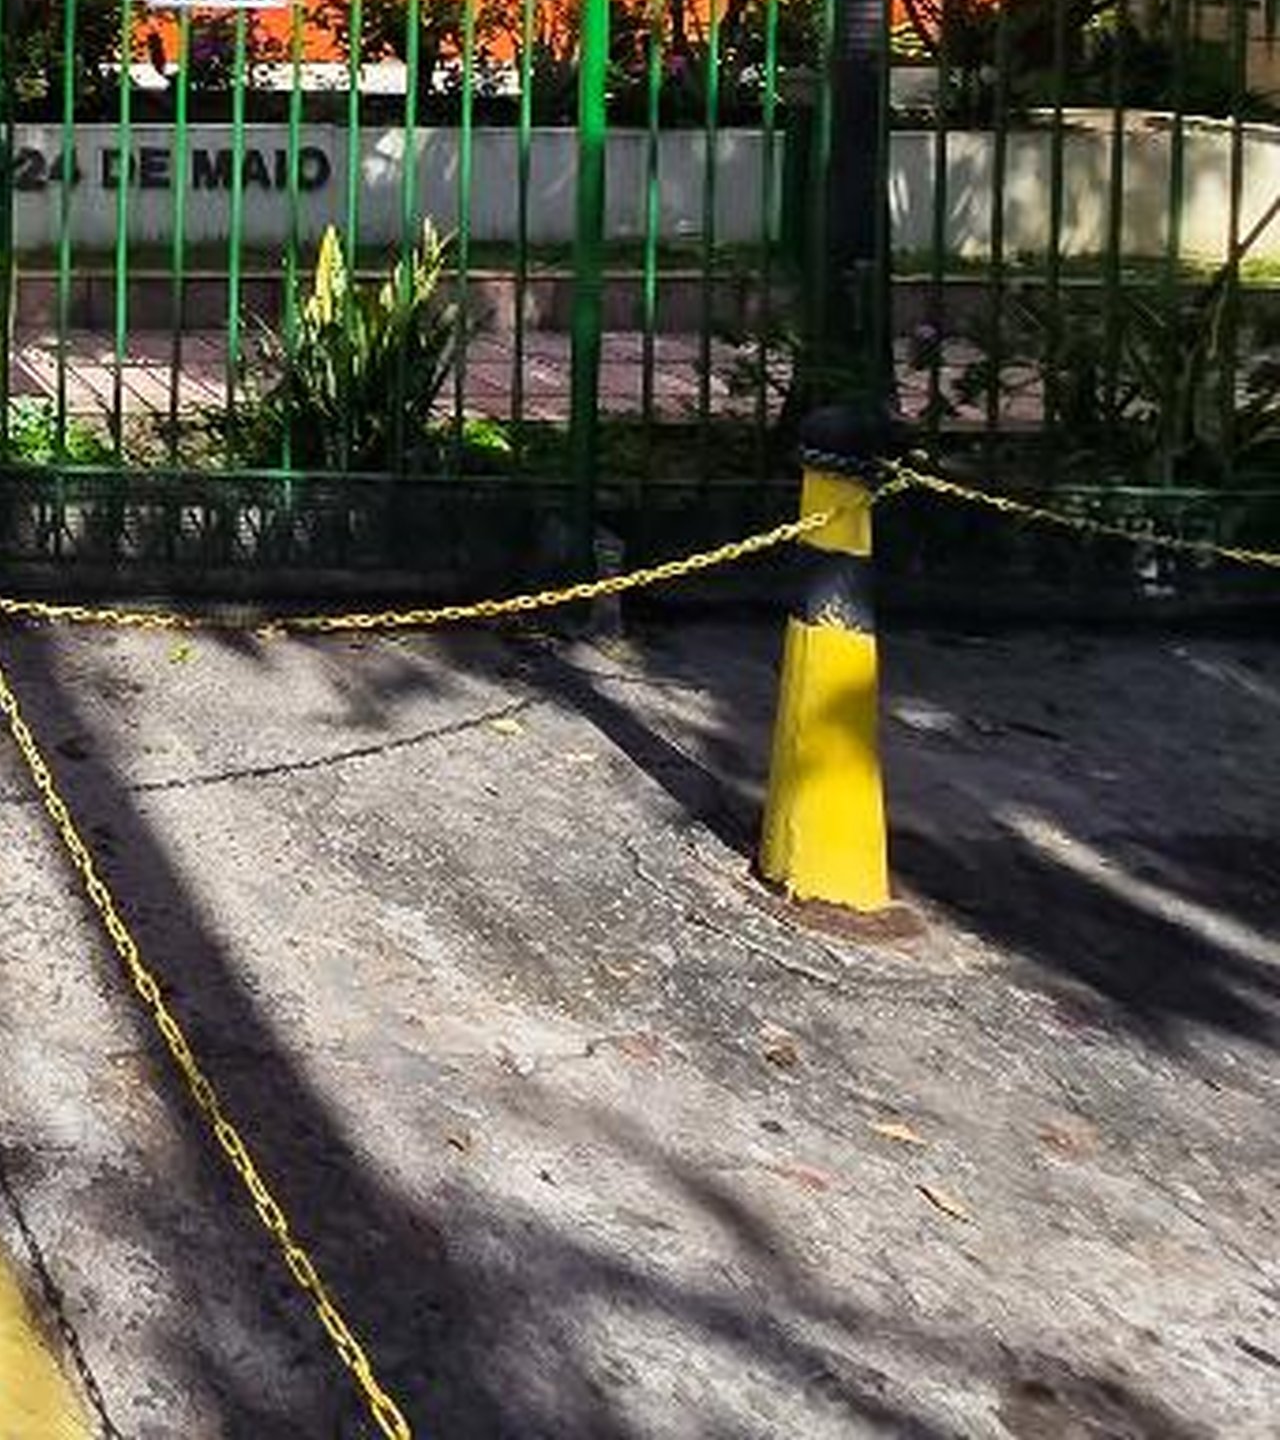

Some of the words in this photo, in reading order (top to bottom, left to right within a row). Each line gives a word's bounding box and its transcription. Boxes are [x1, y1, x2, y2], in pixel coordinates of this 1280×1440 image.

[13, 146, 81, 191] 24
[101, 146, 171, 190] DE
[191, 146, 333, 192] MAIO
